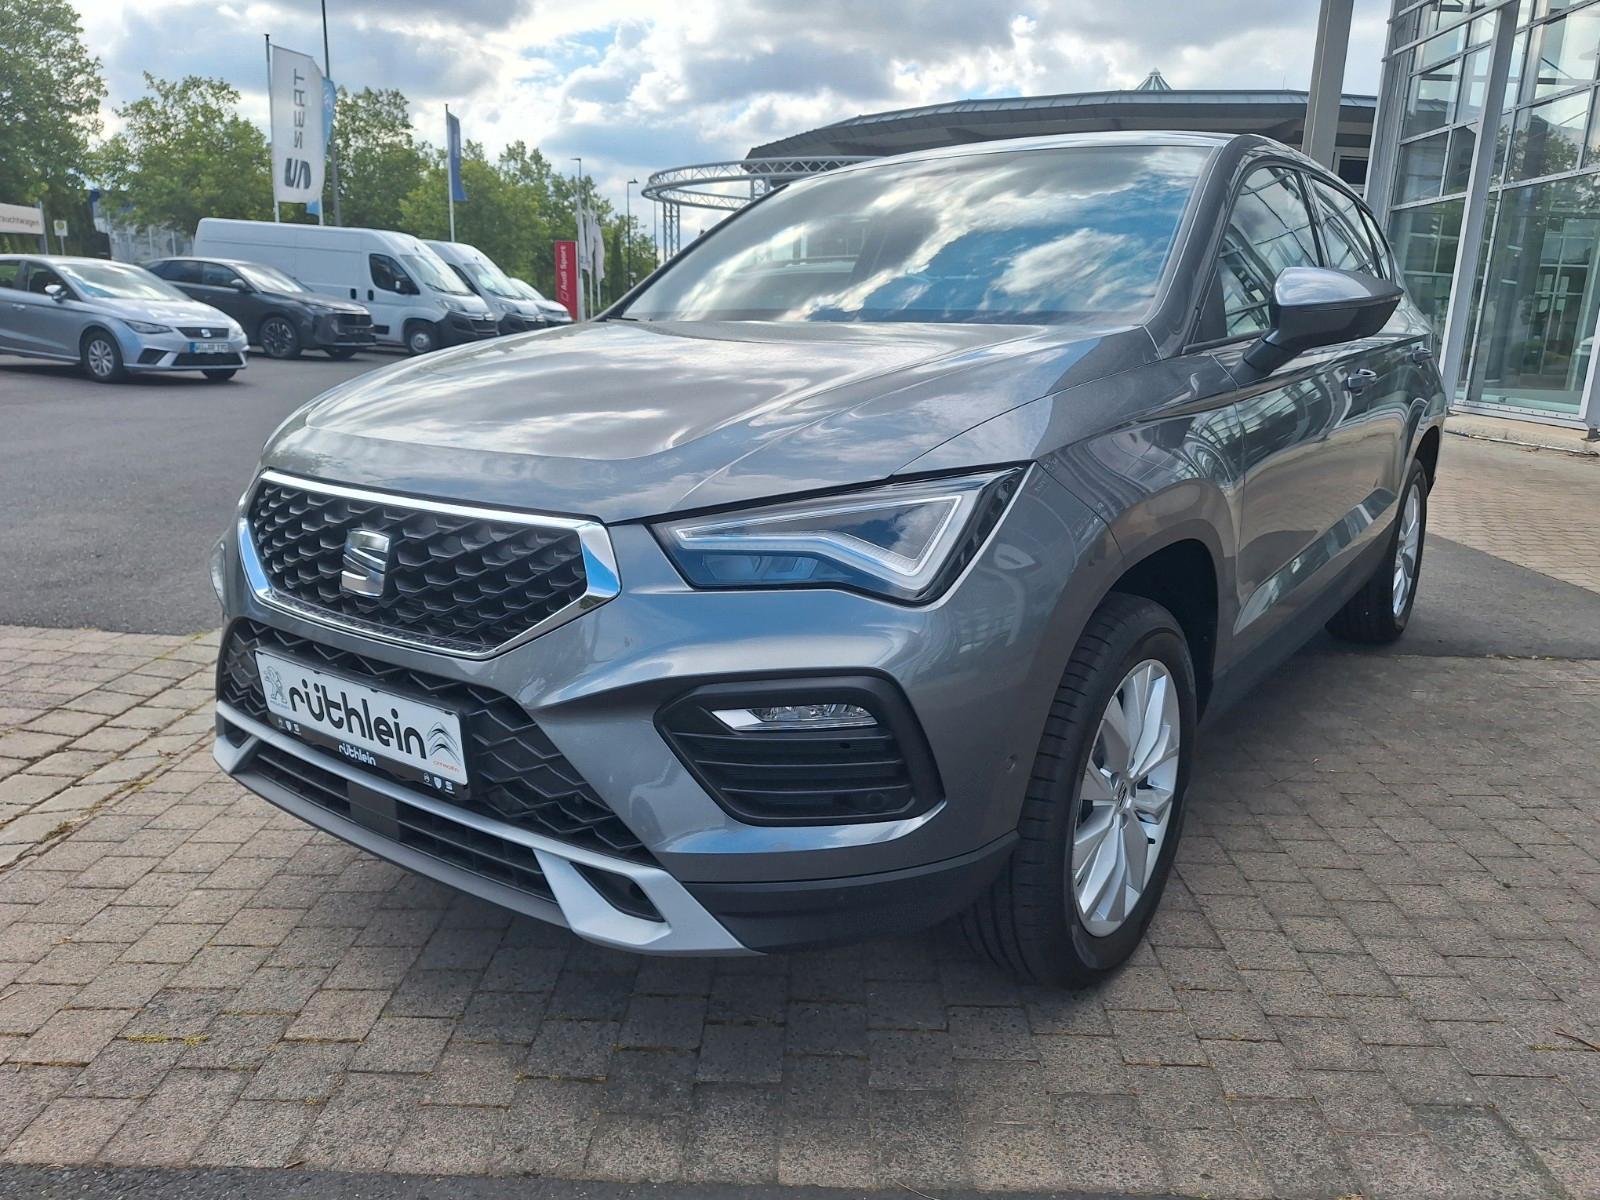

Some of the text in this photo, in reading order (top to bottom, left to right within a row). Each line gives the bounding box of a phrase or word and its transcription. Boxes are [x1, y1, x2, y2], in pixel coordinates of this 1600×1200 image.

[293, 68, 305, 149] SEAT
[560, 245, 568, 291] Audi Sport
[288, 678, 427, 760] rüthlein
[338, 742, 377, 766] rüthlein
